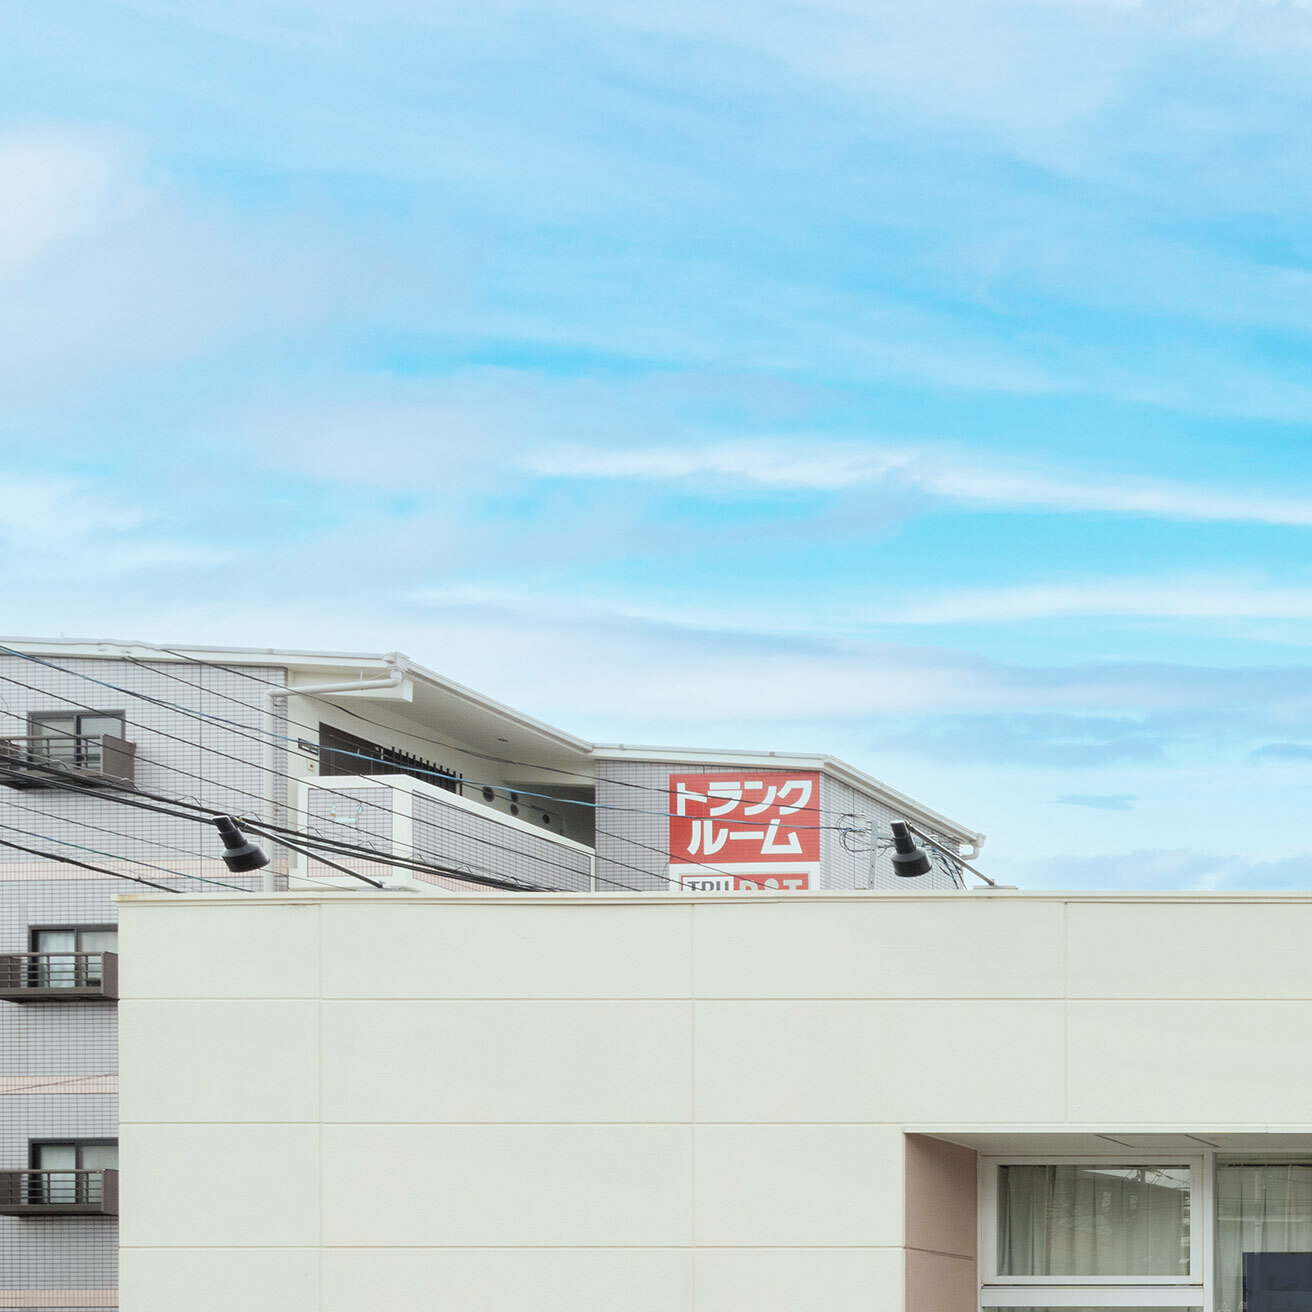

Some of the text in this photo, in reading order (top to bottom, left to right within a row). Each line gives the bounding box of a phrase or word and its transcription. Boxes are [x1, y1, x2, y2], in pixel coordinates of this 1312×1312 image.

[676, 780, 812, 817] トランク
[686, 819, 803, 855] ルーム
